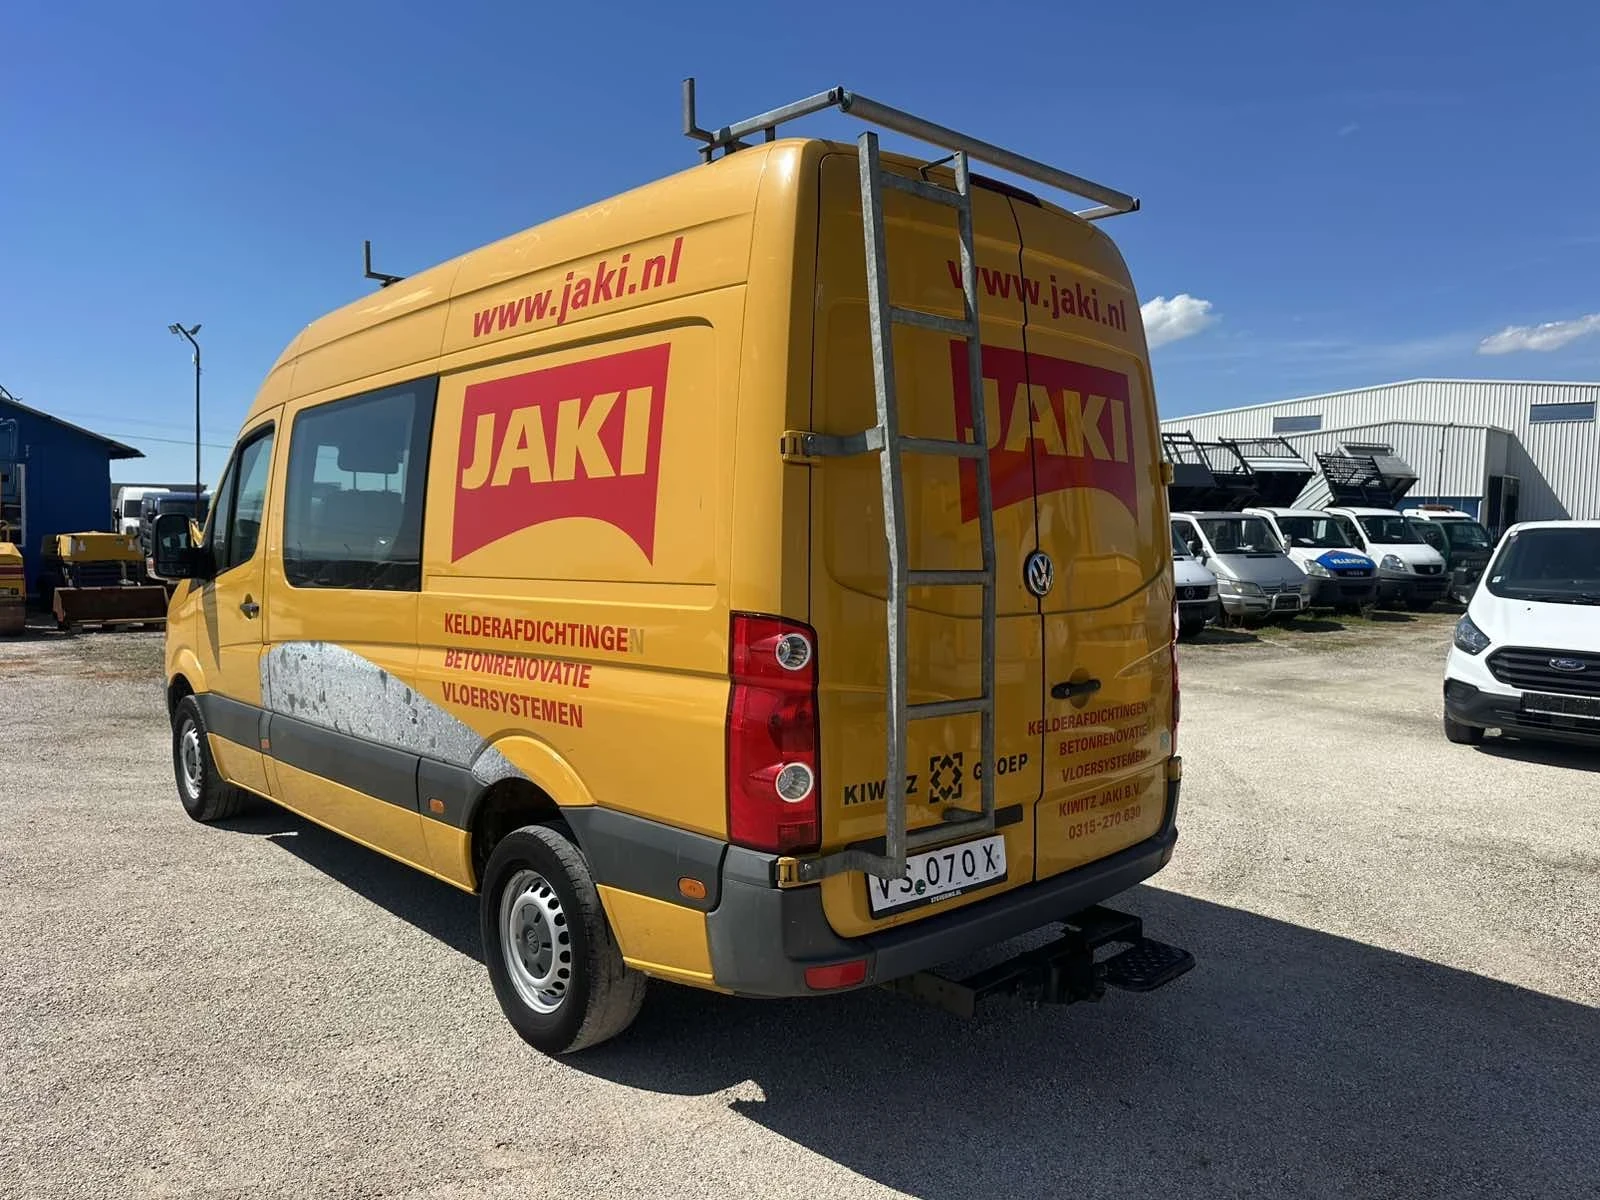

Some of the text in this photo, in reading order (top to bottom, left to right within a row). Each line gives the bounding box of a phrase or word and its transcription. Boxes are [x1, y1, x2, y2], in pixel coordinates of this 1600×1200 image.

[473, 236, 684, 338] www.jaki.nl
[461, 386, 653, 490] JAKI
[964, 377, 1129, 463] JAKI
[444, 648, 592, 689] BETONRENOVATIE
[442, 681, 583, 728] VLOERSYSTEMEN
[1028, 701, 1148, 736] KELDERAFDICHTINGEN
[1059, 723, 1148, 756] BETONRENOVATIE
[844, 753, 1028, 805] KIWZ GOEP
[1062, 749, 1149, 782] VLOERSYSTEMEN
[1058, 795, 1097, 817] KIWITZ
[1100, 782, 1122, 806] JAKI
[1068, 811, 1121, 839] 0315-270
[926, 849, 976, 886] 070
[982, 844, 996, 872] X
